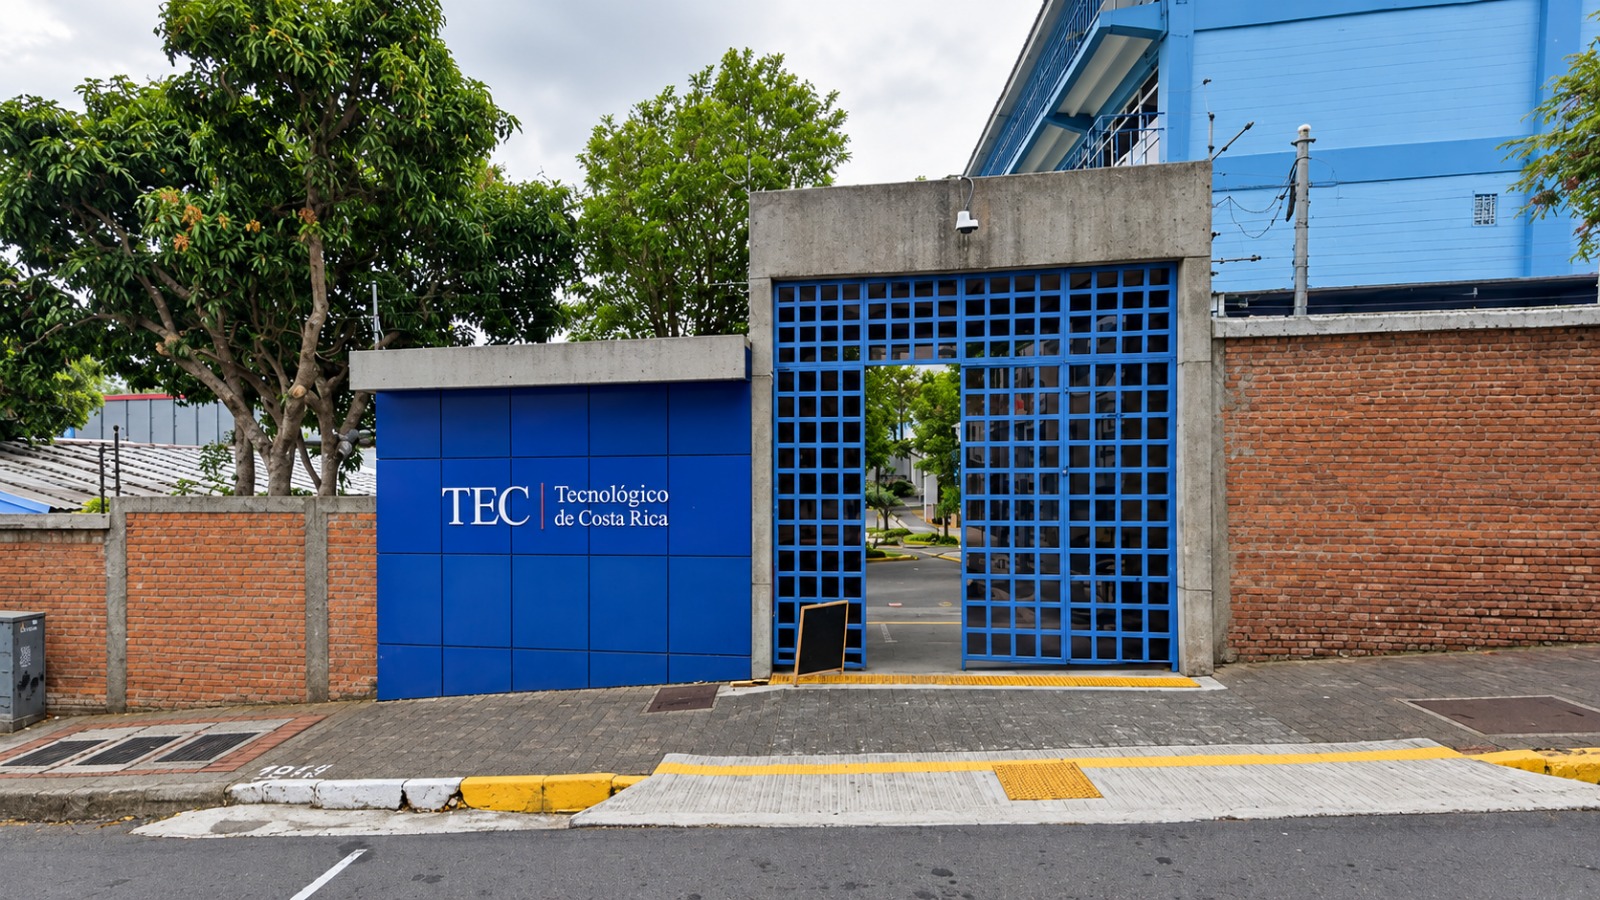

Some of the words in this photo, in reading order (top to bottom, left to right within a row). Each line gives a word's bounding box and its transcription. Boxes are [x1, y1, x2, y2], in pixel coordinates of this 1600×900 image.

[442, 486, 530, 526] TEC
[554, 484, 669, 508] Tecnológico
[554, 509, 575, 526] de
[578, 509, 626, 527] Costa
[629, 509, 669, 527] Rica
